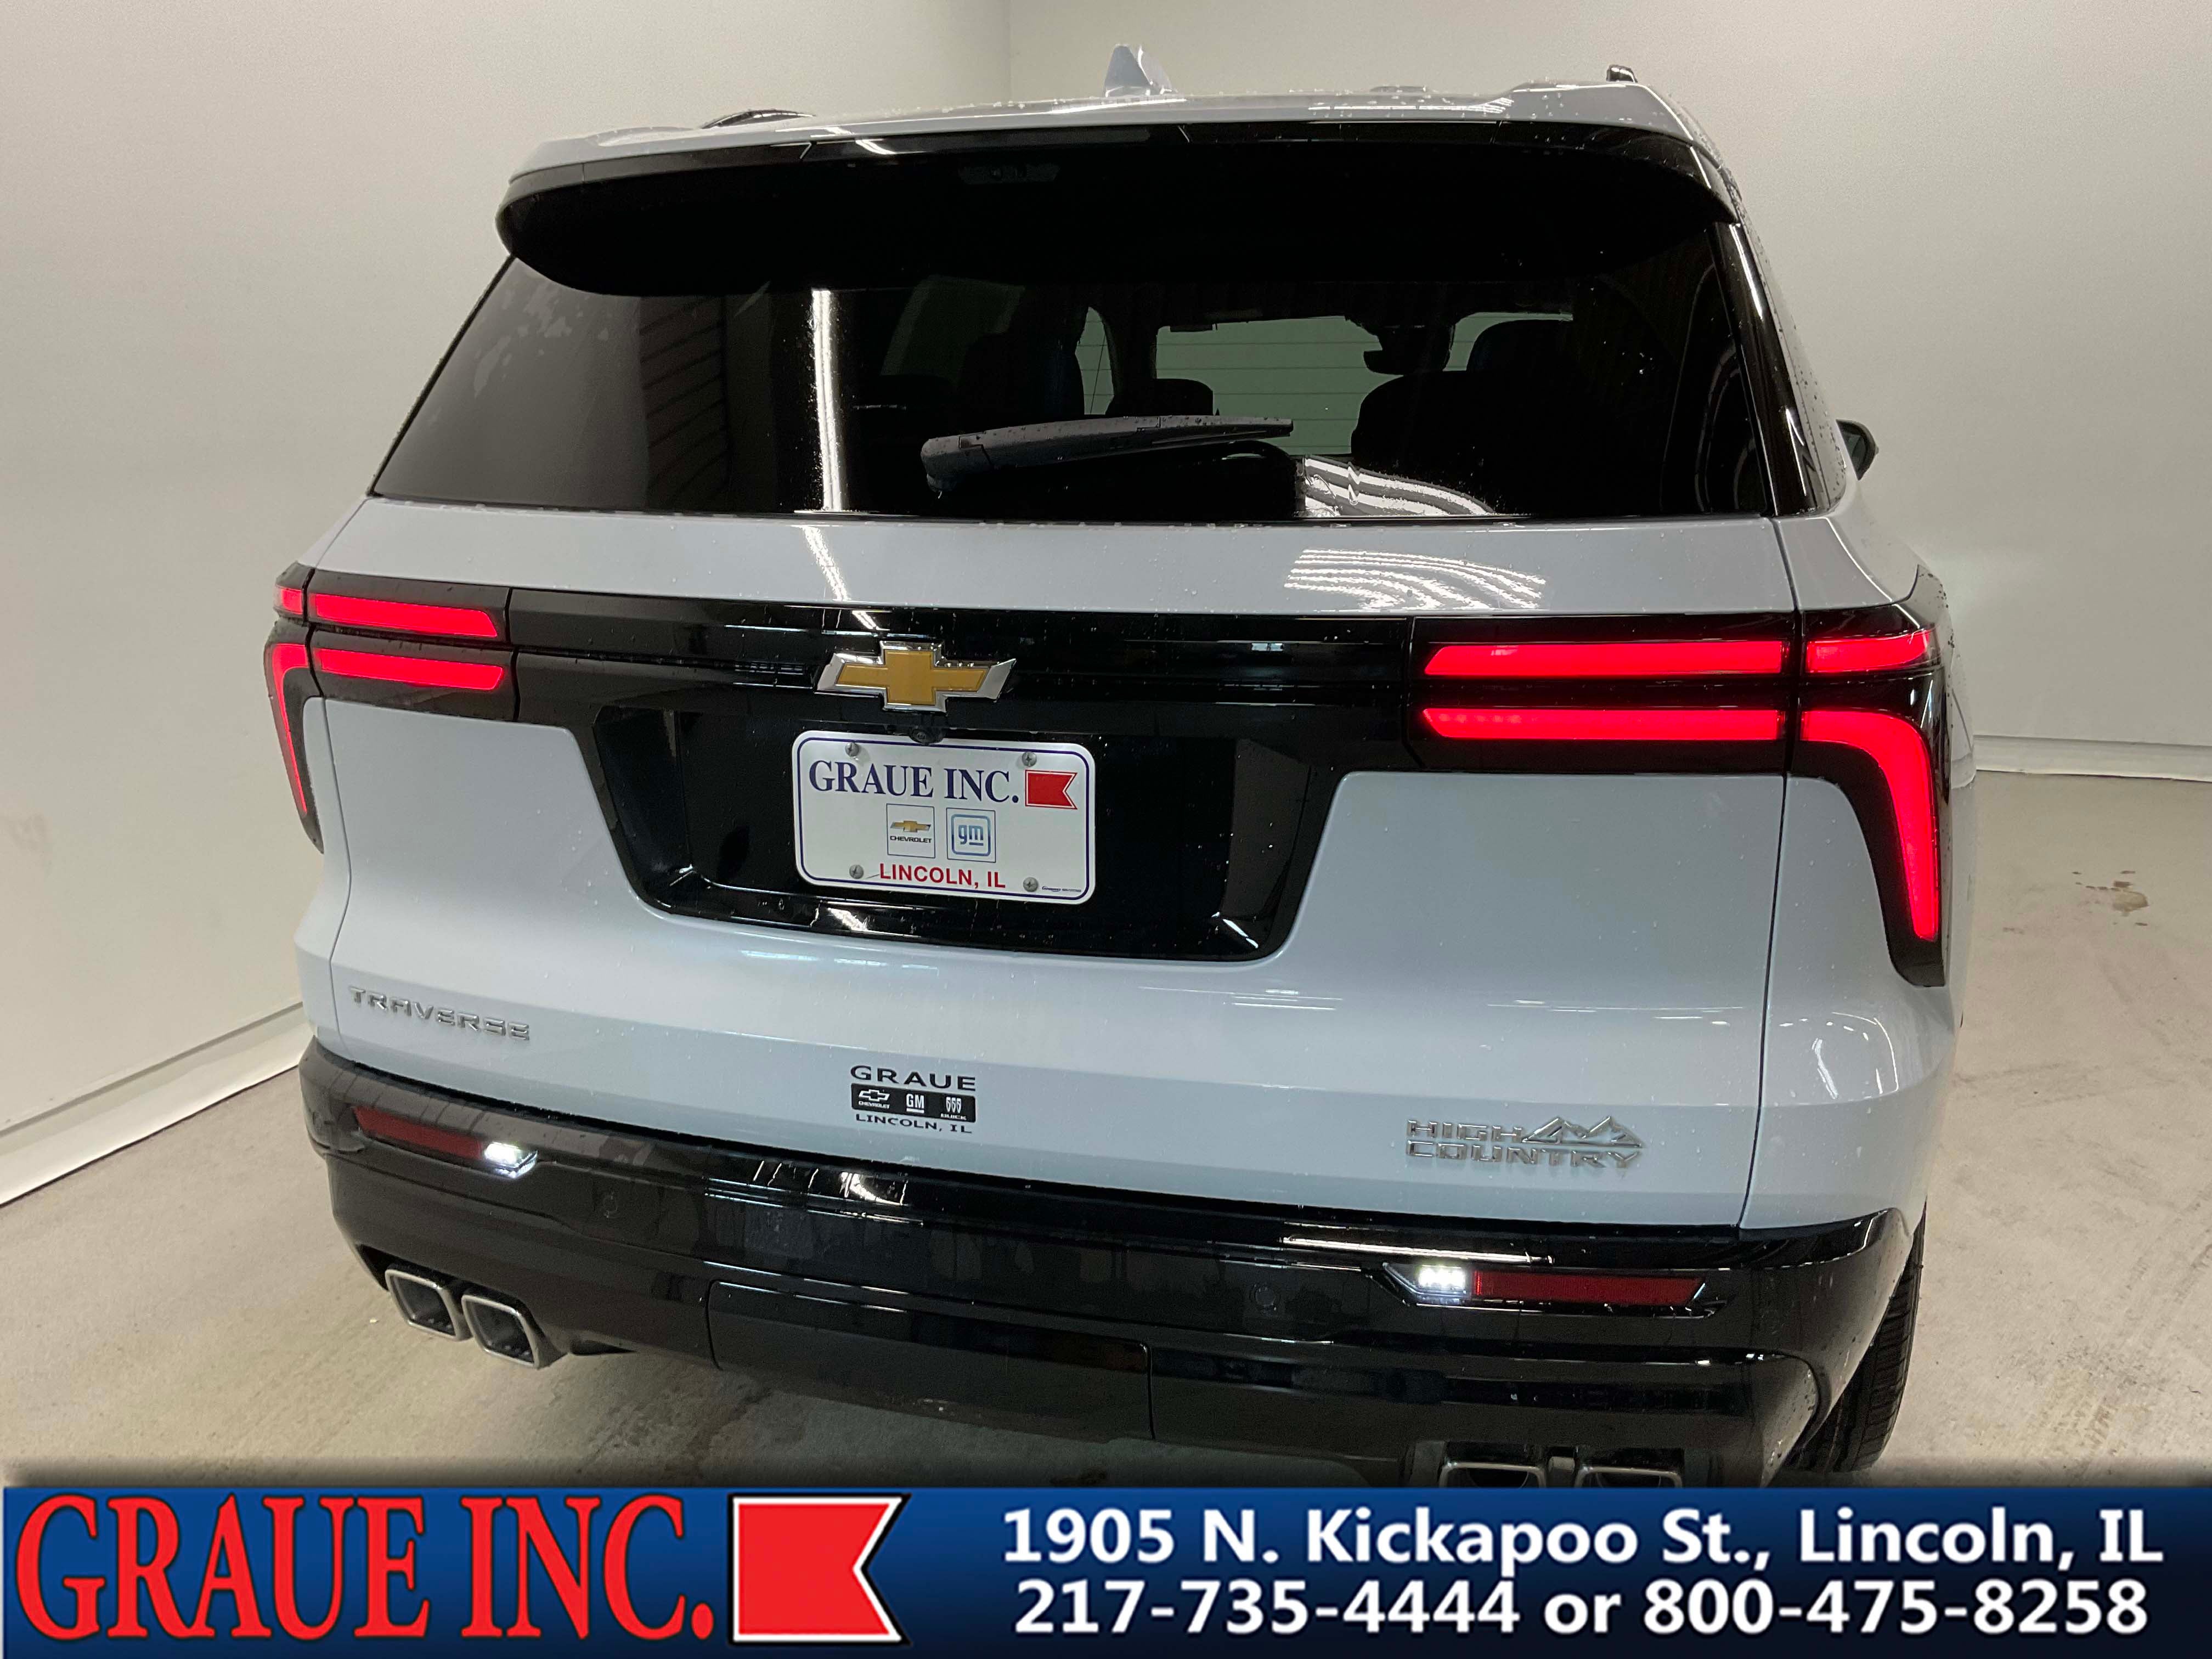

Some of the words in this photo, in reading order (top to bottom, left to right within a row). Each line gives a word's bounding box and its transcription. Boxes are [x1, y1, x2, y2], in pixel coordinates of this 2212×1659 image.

[809, 760, 934, 798] GRAUE
[944, 768, 1019, 803] INC.
[890, 836, 932, 844] CHEVROLET
[958, 825, 984, 845] gm
[879, 863, 979, 889] LINCOLN,
[987, 871, 1006, 889] IL
[349, 986, 530, 1041] TRAVERSE
[850, 1065, 976, 1092] GRAUE
[858, 1100, 890, 1109] CHEVROLET
[906, 1093, 925, 1109] GM
[856, 1113, 943, 1132] LINCOLN,
[950, 1124, 973, 1134] IL
[940, 1113, 967, 1121] BUICK
[1407, 1119, 1522, 1142] HIGH
[1406, 1140, 1642, 1169] COUNTRY
